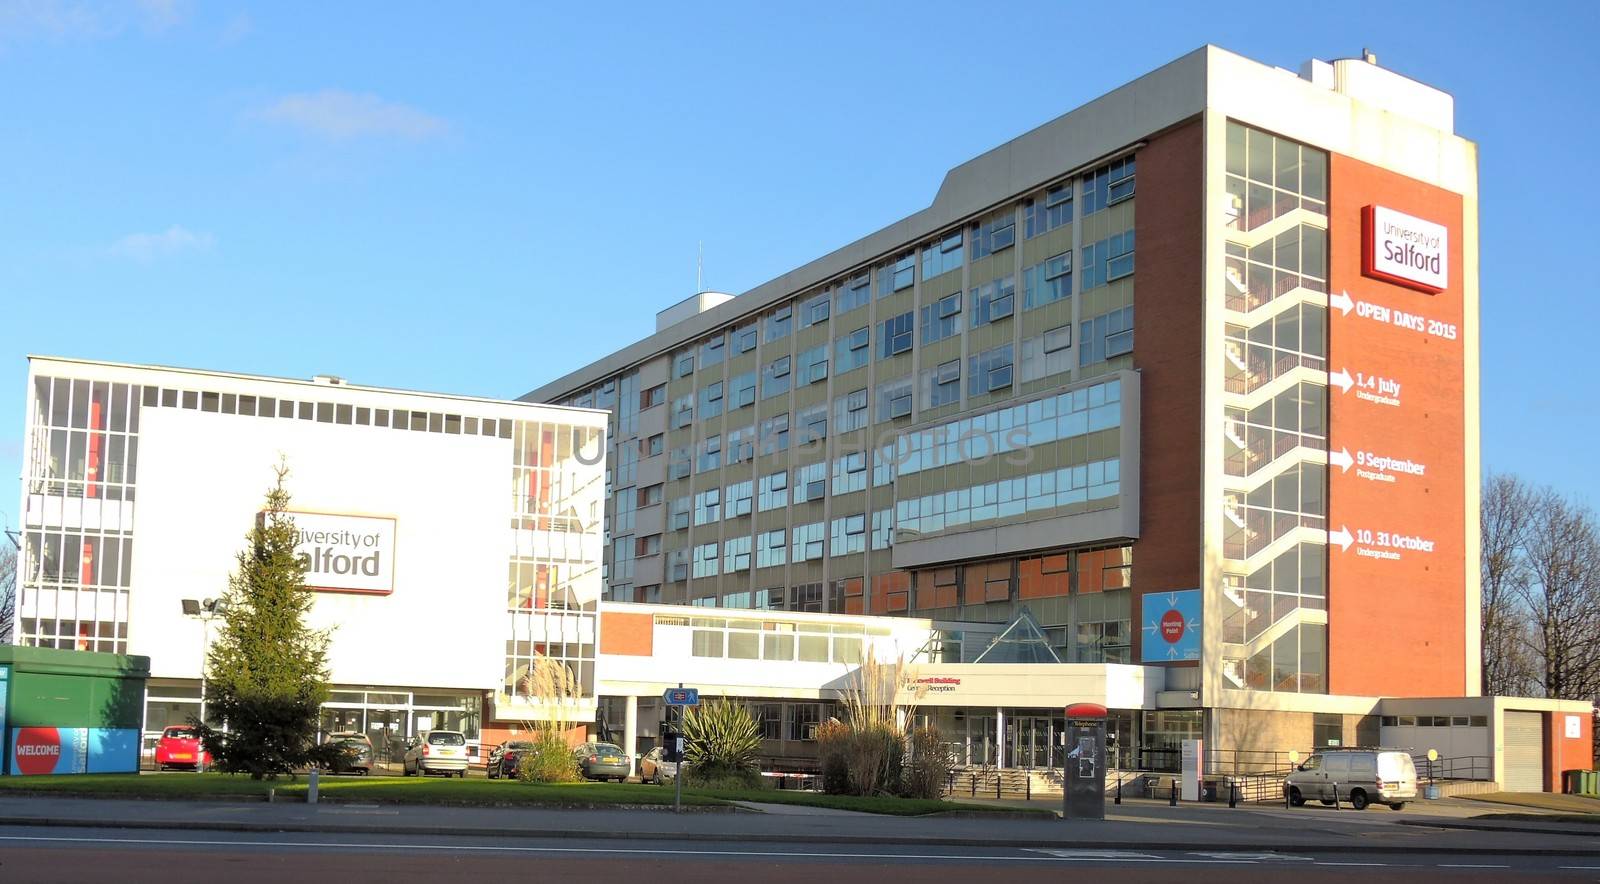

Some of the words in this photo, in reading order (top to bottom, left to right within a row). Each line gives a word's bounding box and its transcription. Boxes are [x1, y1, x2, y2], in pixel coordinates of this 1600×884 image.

[1384, 221, 1430, 247] University
[1430, 237, 1440, 249] of
[1384, 239, 1440, 275] Salford
[1356, 301, 1390, 323] OPEN
[1394, 310, 1425, 332] DAYS
[1427, 319, 1457, 340] 2015
[1356, 390, 1400, 407] Undergraduate
[1378, 378, 1400, 396] July
[1356, 450, 1365, 465] 9
[1365, 452, 1425, 476] September
[1356, 468, 1396, 482] Postgraduate
[289, 527, 361, 550] niversity
[363, 531, 381, 547] of
[1357, 528, 1375, 546] 10,
[1376, 531, 1391, 547] 31
[1391, 533, 1435, 552] October
[297, 546, 381, 577] alford
[1356, 547, 1401, 560] Undergraduate
[17, 744, 60, 756] WELCOME
